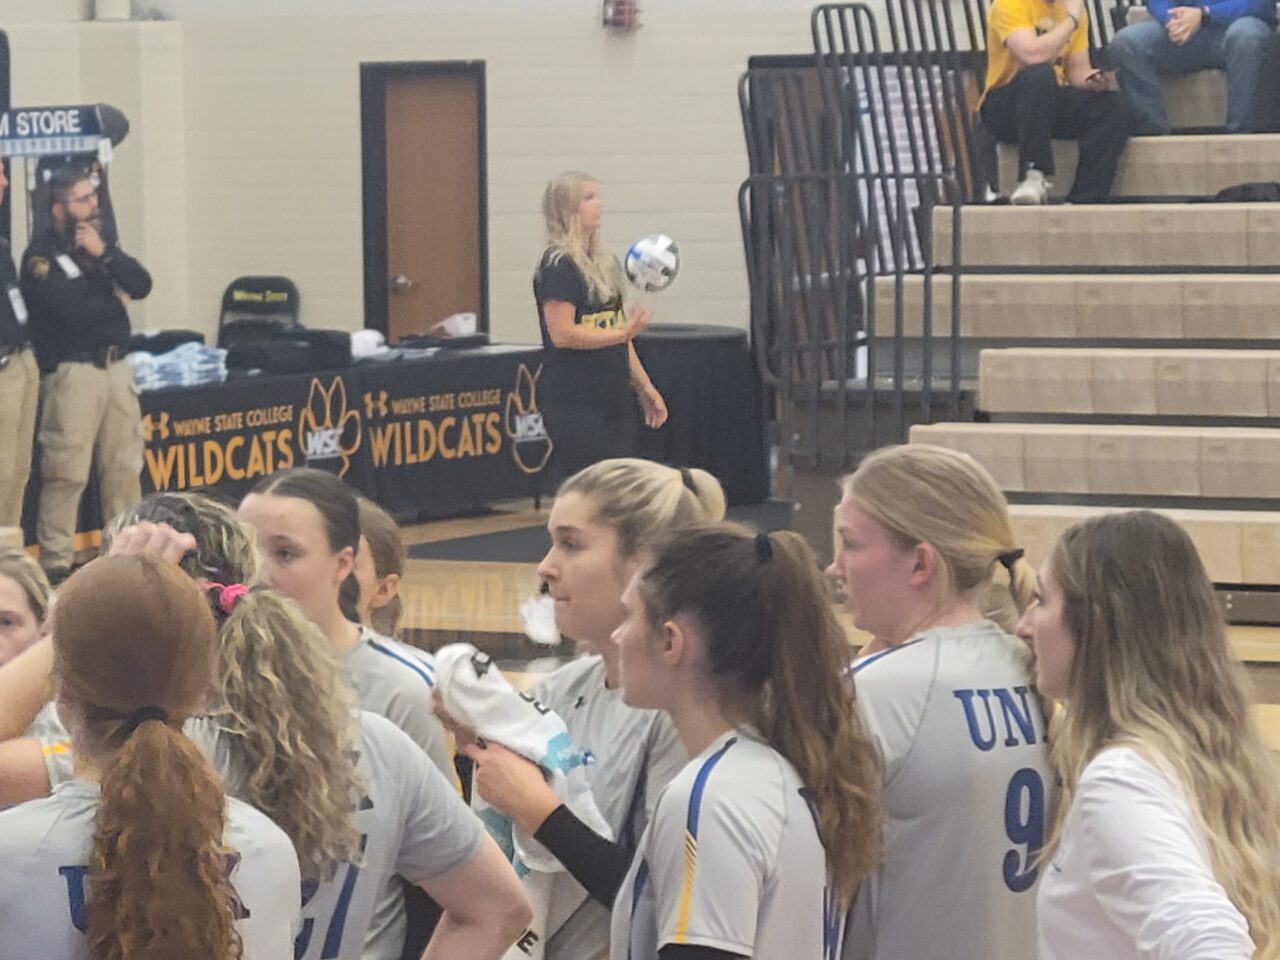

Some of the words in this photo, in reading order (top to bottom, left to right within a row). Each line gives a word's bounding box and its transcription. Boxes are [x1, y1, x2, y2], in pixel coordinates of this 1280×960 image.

[17, 109, 81, 134] STORE
[173, 416, 211, 437] WAYNE
[215, 411, 243, 432] STATE
[246, 405, 294, 427] COLLEGE
[392, 396, 425, 415] WAYNE
[429, 392, 455, 412] STATE
[458, 388, 501, 408] COLLEGE
[144, 428, 295, 491] WILDCATS
[369, 412, 502, 468] WILDCATS
[952, 685, 1049, 751] UN
[1002, 767, 1045, 893] 9
